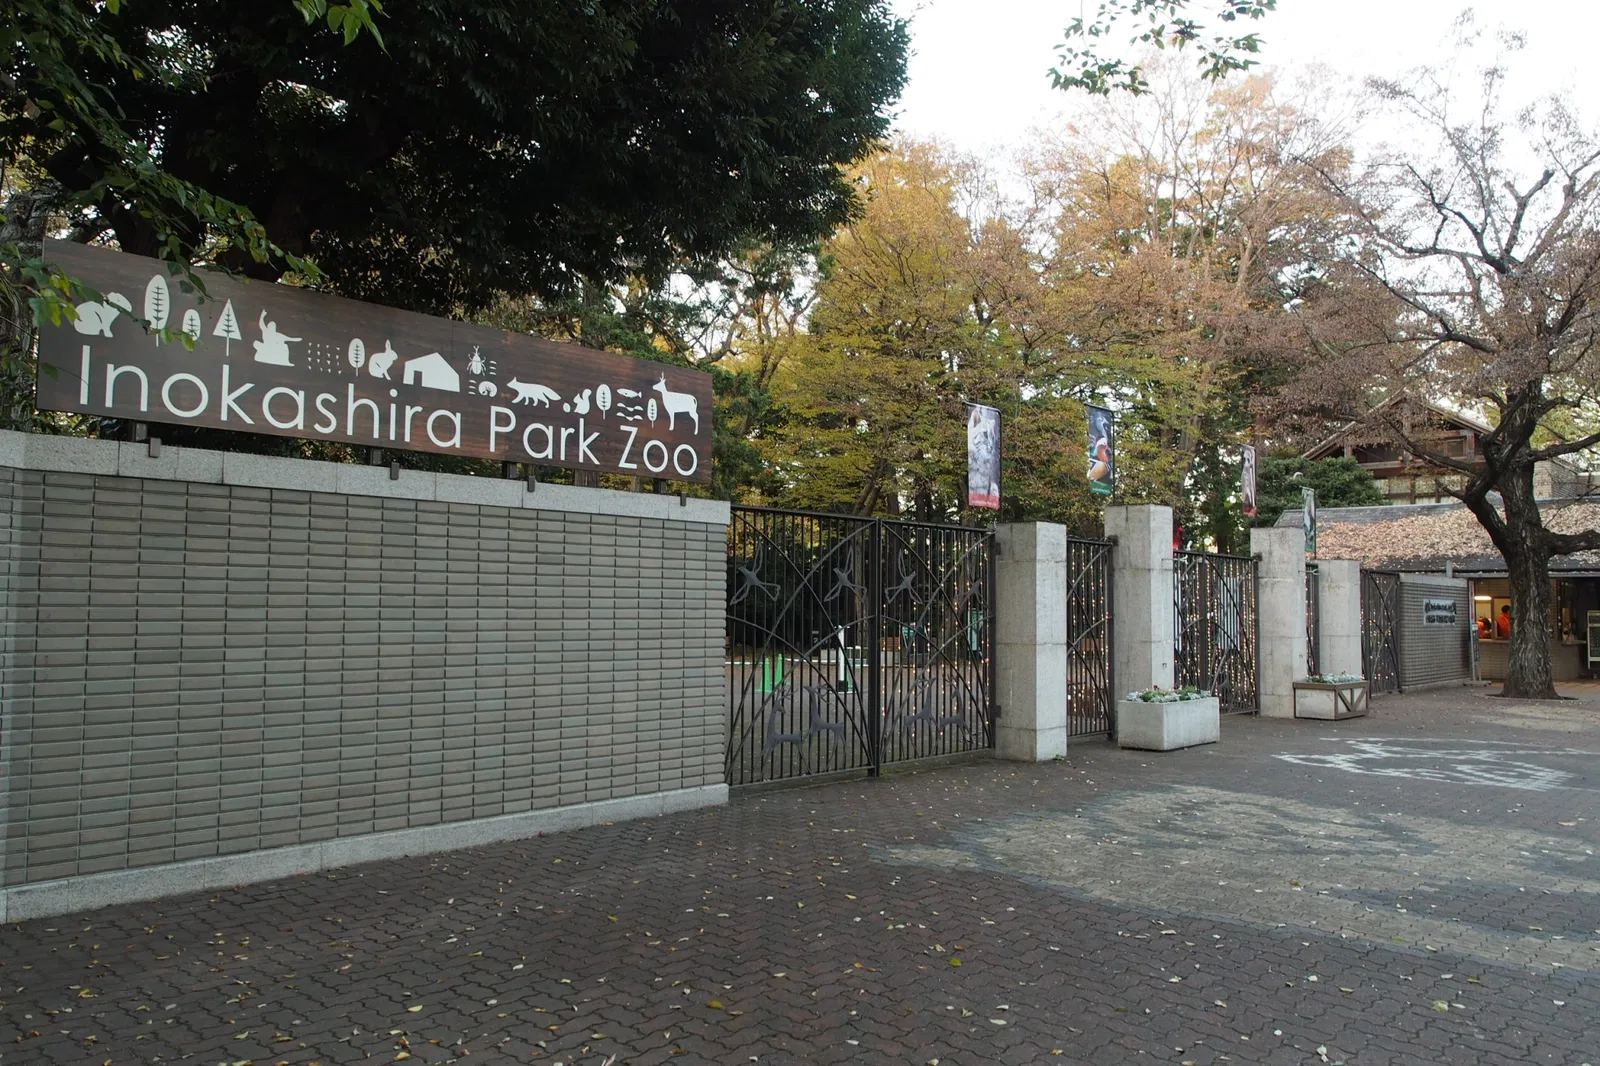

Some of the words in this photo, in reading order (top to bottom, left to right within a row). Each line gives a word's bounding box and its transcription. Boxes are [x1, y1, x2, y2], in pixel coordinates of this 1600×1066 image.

[79, 344, 462, 449] Inokashira
[489, 405, 601, 466] Park
[618, 424, 698, 476] Zoo
